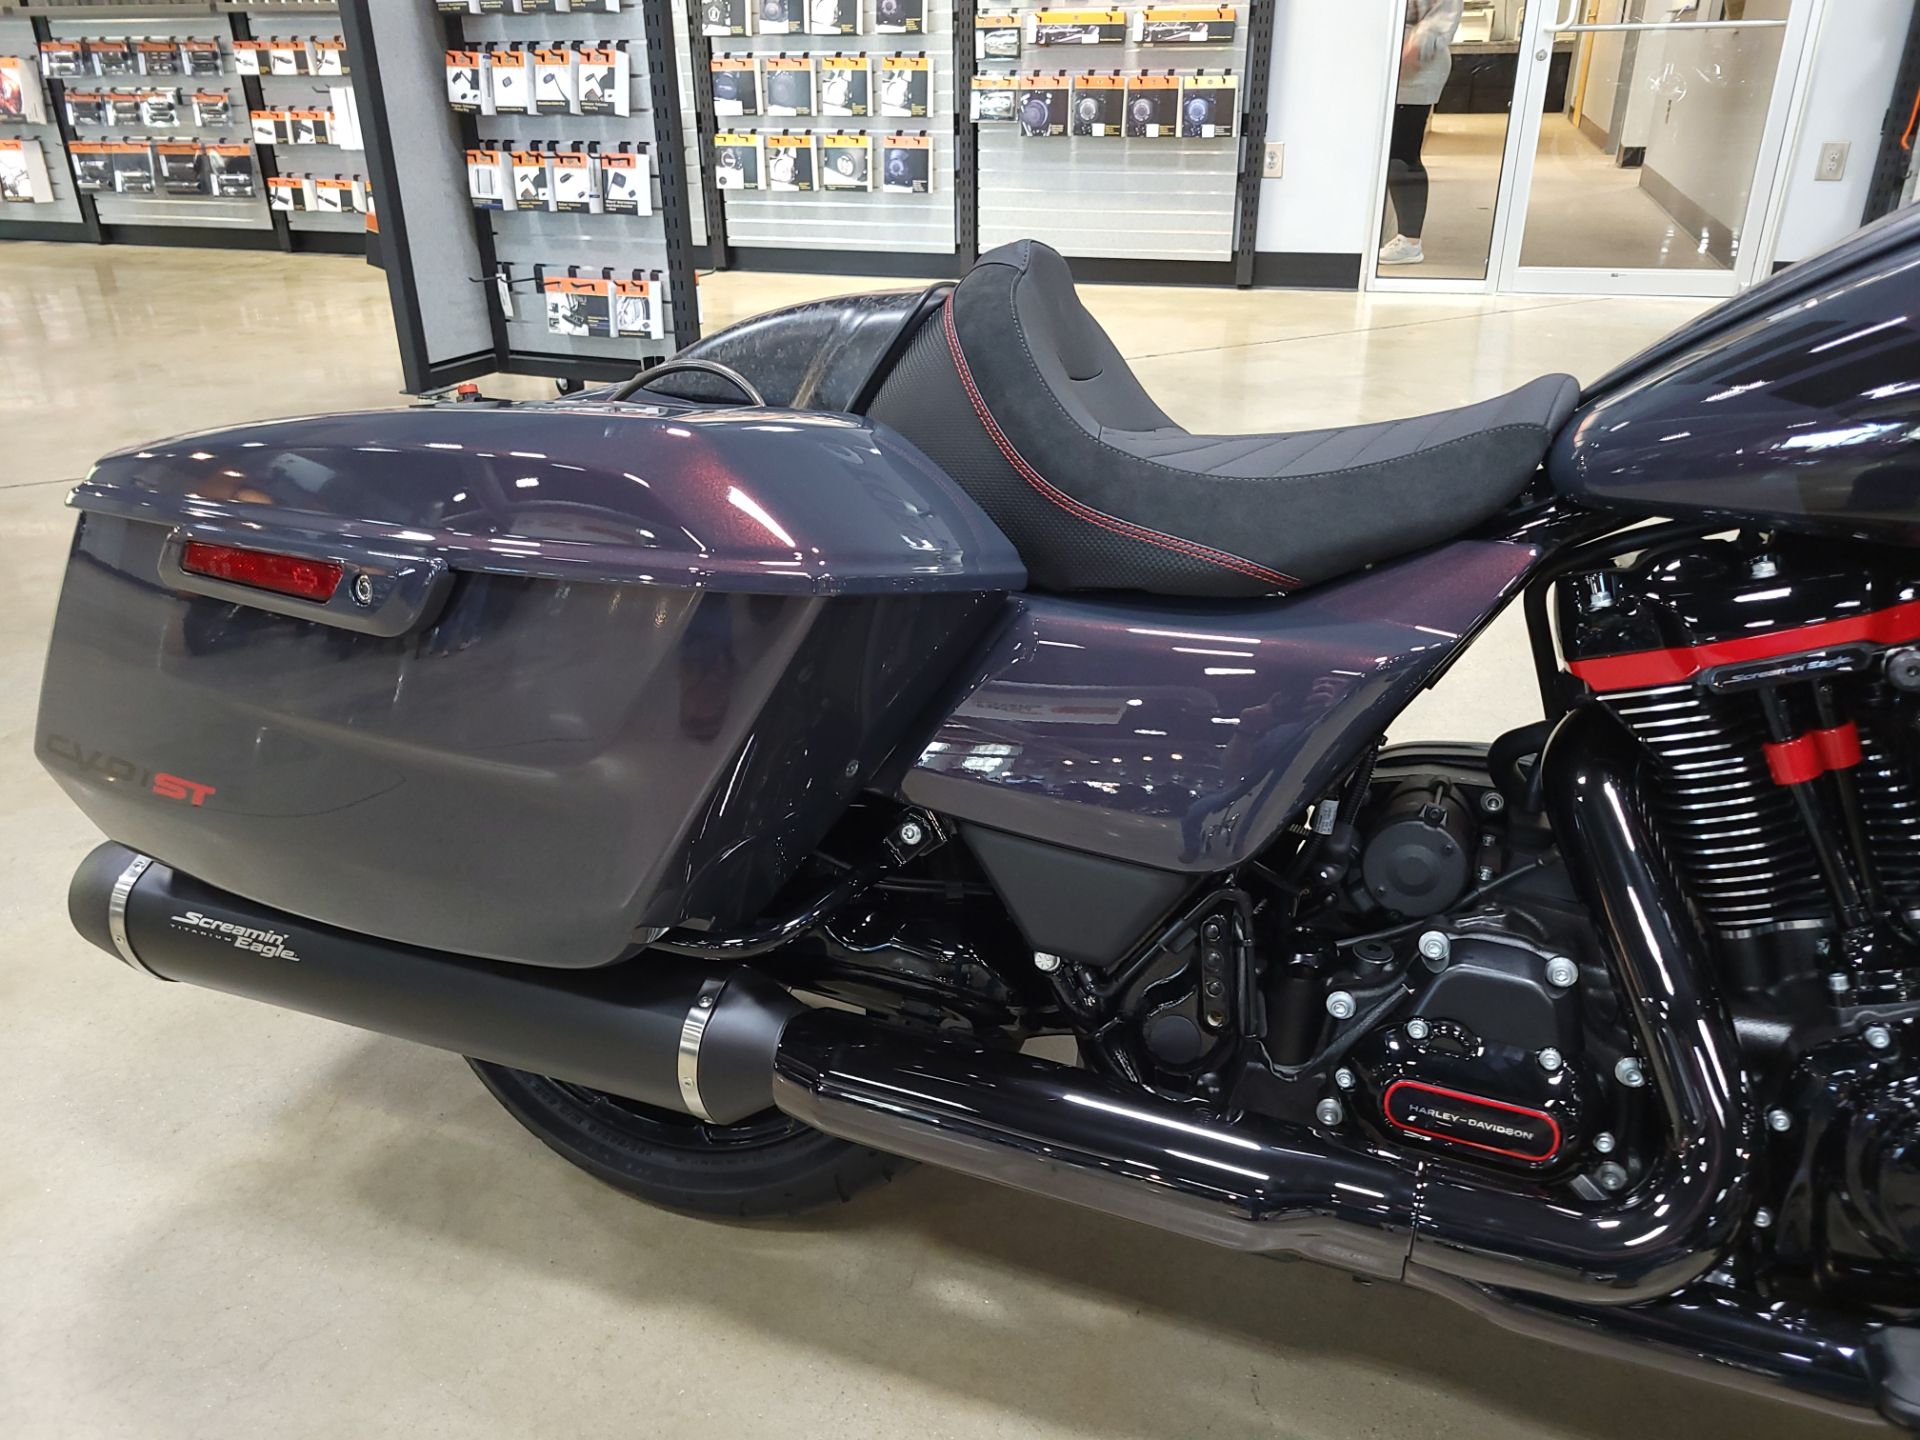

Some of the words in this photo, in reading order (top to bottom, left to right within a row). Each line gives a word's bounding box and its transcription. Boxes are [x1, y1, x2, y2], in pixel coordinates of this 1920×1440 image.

[171, 911, 290, 945] Screamin'
[234, 935, 300, 961] Eagle
[1409, 1103, 1534, 1140] HARLEY-DAVIDSON
